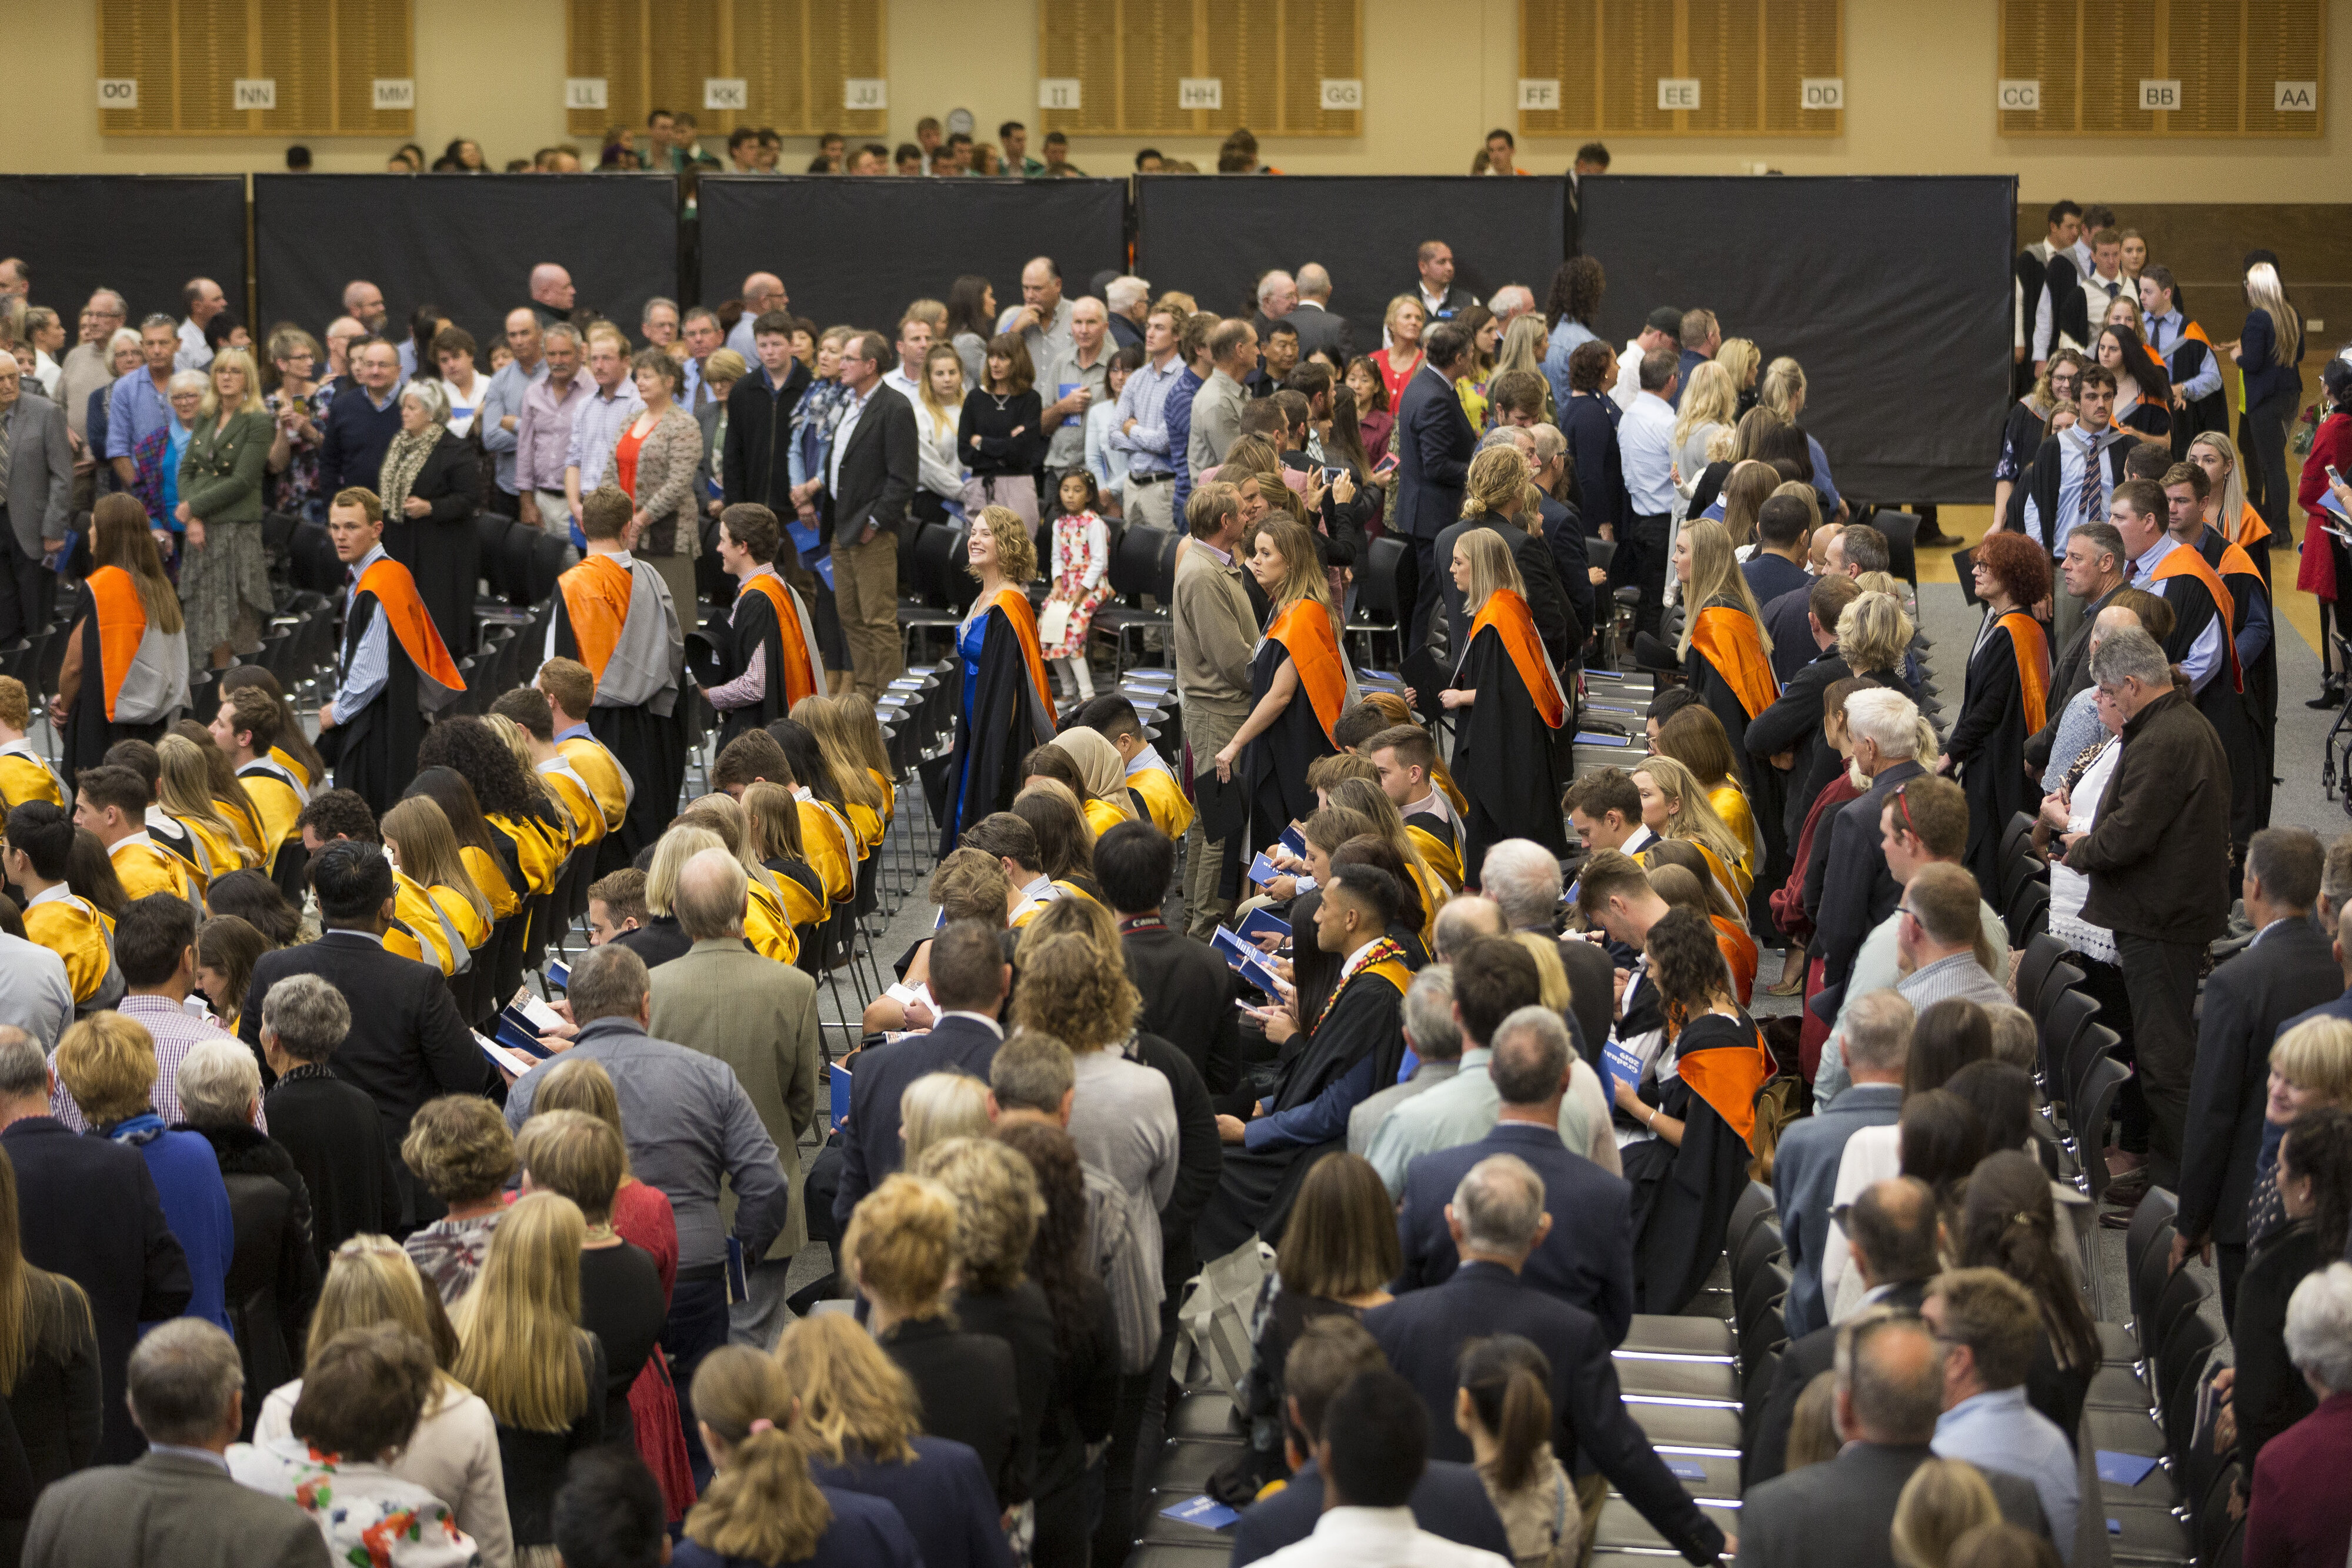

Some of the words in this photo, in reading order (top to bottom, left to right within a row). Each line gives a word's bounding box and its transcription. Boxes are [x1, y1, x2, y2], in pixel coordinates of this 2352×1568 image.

[103, 83, 132, 99] OO
[240, 87, 269, 104] NN
[378, 86, 408, 103] MM
[575, 86, 597, 105] LL
[712, 86, 739, 104] KK
[855, 87, 878, 105] JJ
[1185, 86, 1216, 103] HH
[1326, 86, 1357, 104] GG
[1526, 86, 1552, 104] FF
[1666, 87, 1692, 104] EE
[1808, 86, 1838, 104] DD
[2004, 88, 2034, 105] CC
[2147, 88, 2174, 105] BB
[2281, 89, 2310, 106] AA
[1619, 1052, 1640, 1067] 2019
